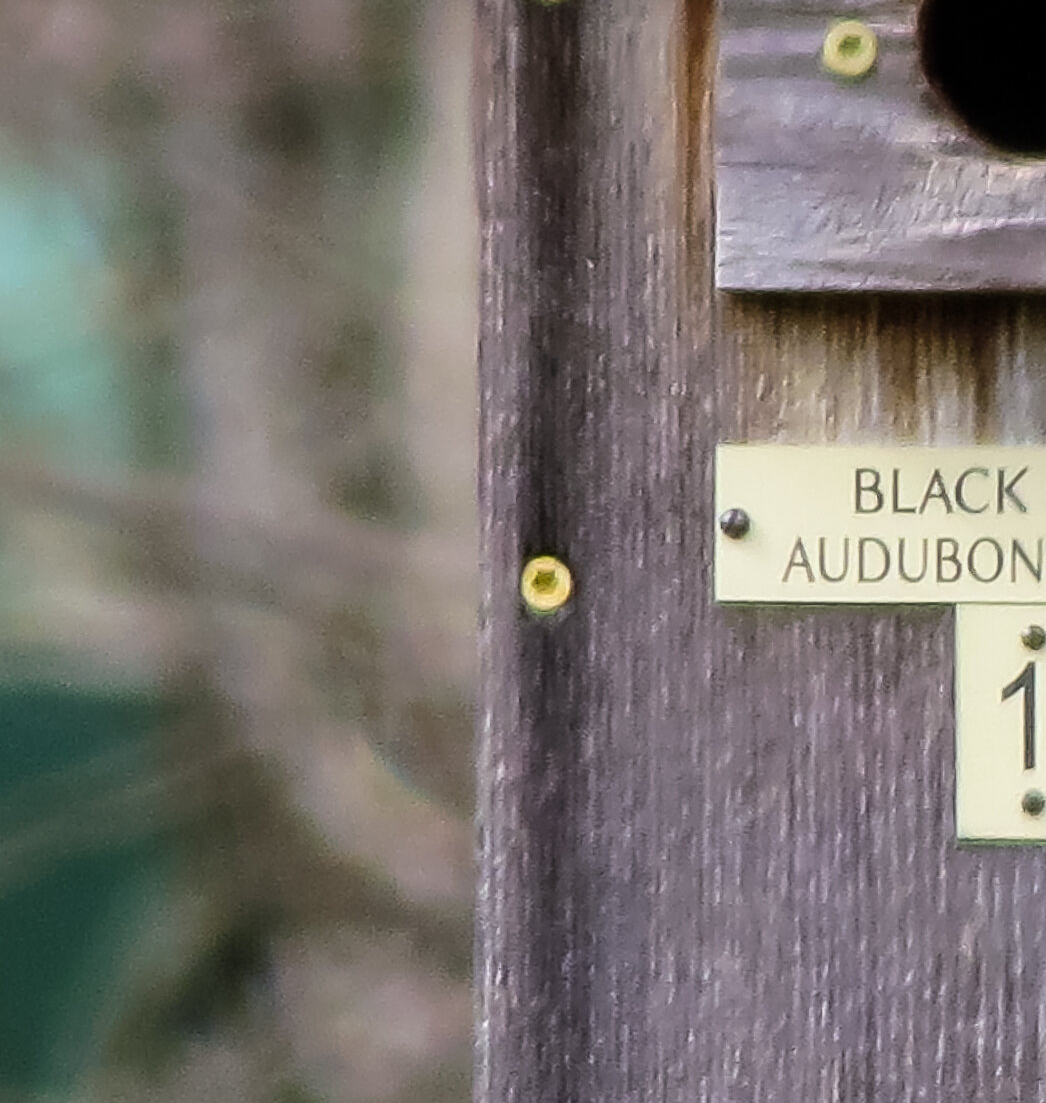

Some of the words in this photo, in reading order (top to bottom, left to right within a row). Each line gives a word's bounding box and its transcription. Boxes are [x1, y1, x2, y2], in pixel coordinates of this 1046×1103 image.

[855, 467, 1028, 514] BLACK
[783, 536, 1043, 584] AUDUBON
[1001, 661, 1036, 770] 1
